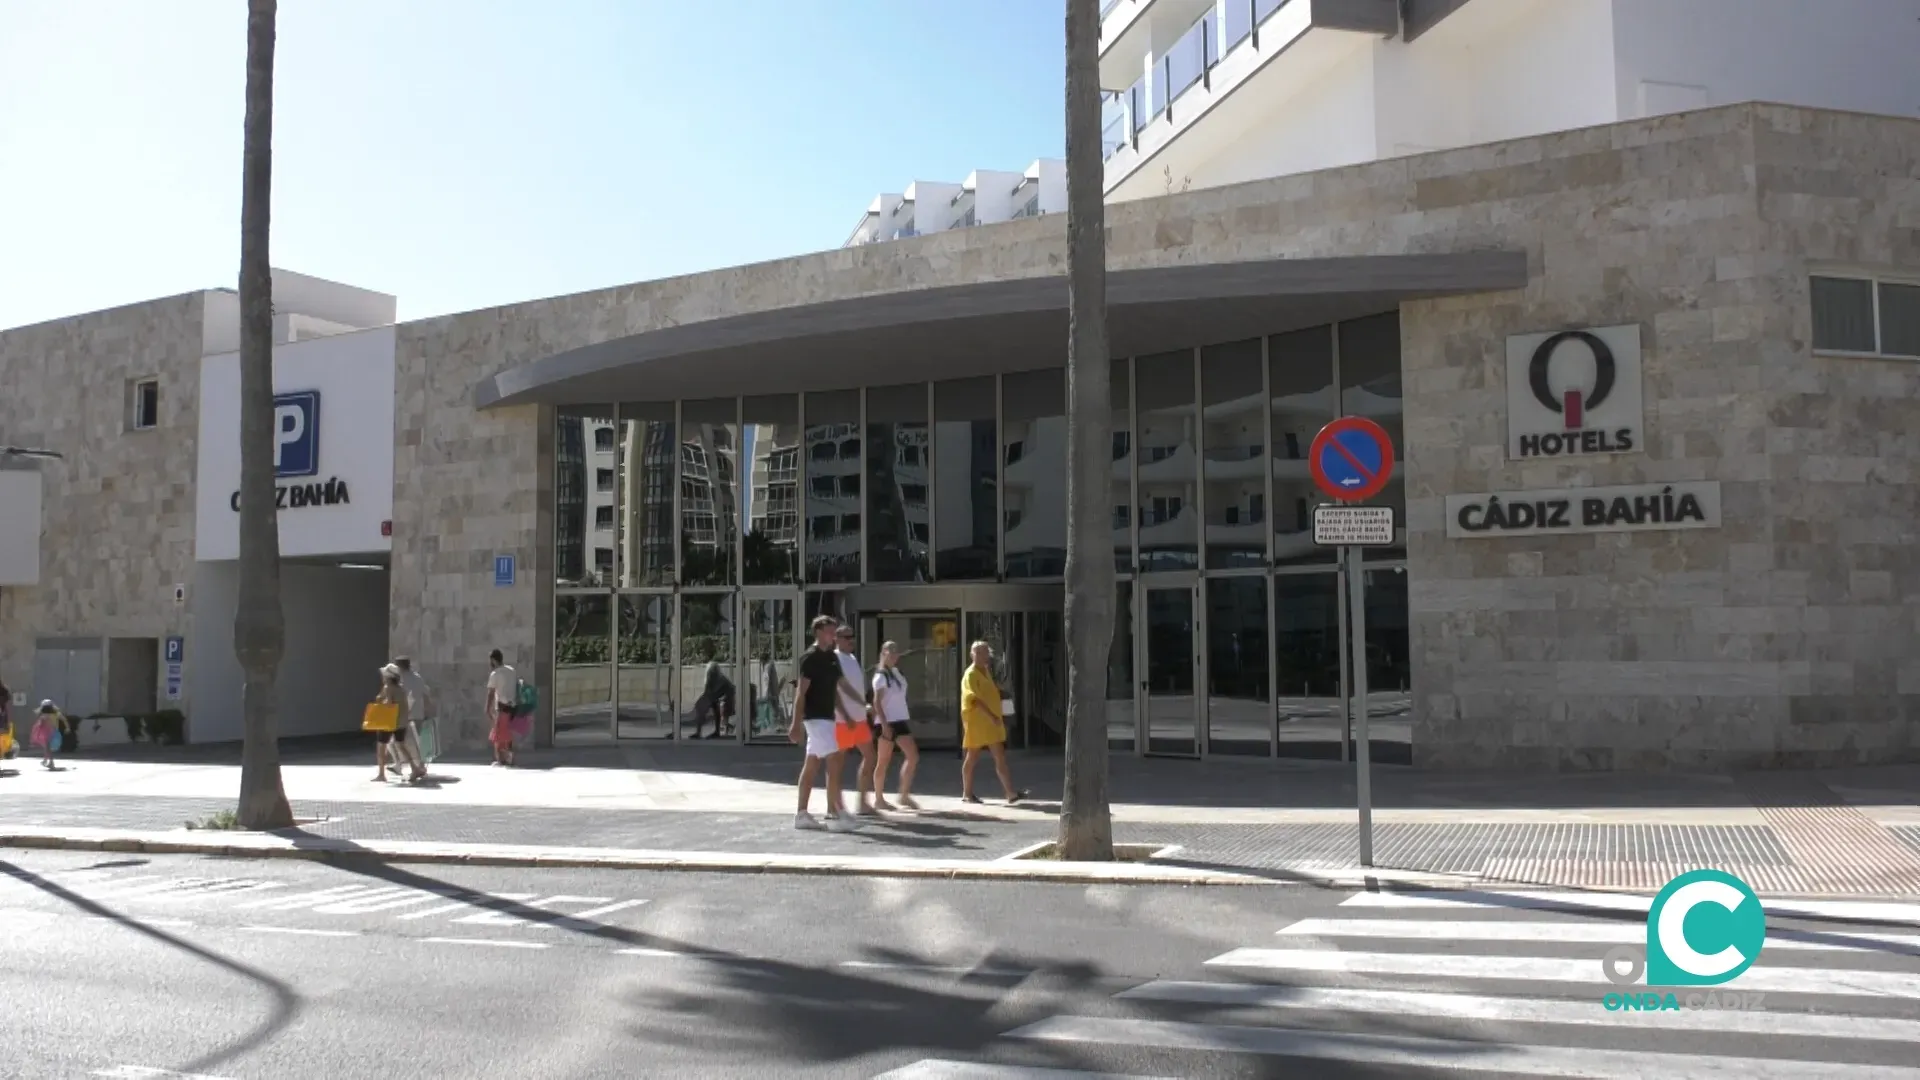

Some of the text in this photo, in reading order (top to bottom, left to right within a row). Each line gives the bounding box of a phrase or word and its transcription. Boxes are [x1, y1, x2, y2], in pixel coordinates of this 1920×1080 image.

[274, 404, 305, 467] P
[1519, 428, 1633, 457] HOTELS
[290, 477, 350, 508] BAHÍA
[1458, 485, 1705, 532] CÁDIZ BAHÍA
[168, 640, 178, 659] P
